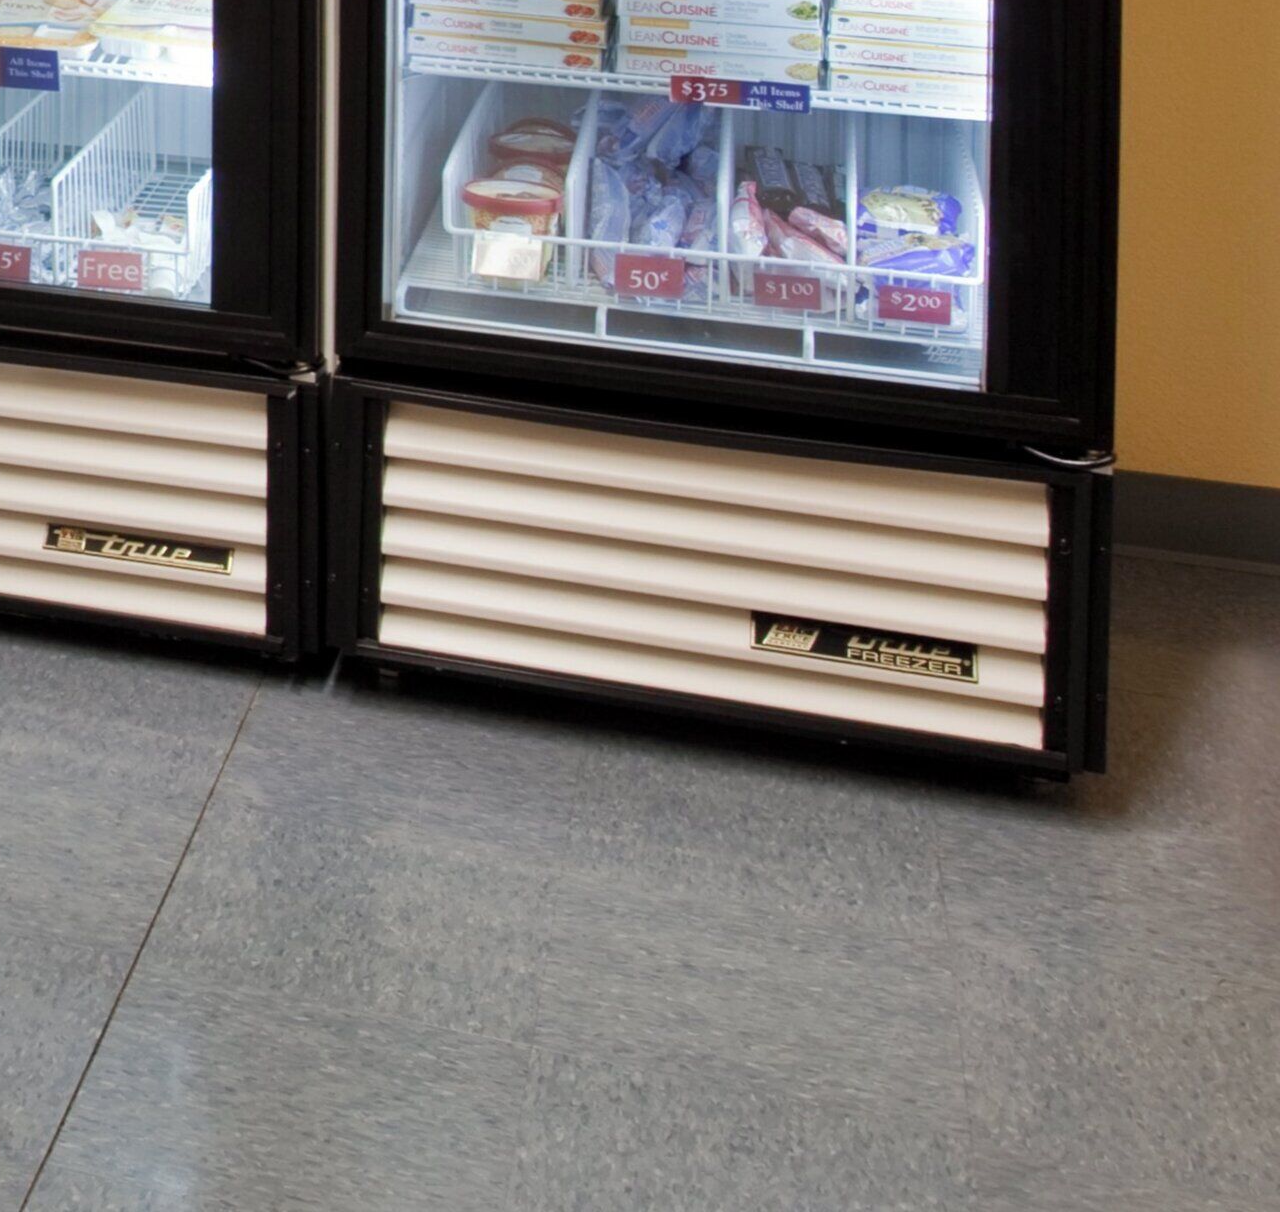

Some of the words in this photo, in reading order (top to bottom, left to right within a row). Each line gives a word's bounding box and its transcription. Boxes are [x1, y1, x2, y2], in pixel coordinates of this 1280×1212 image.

[9, 57, 23, 66] All
[26, 58, 51, 68] Items
[8, 68, 29, 77] This
[31, 69, 54, 79] Shelf
[751, 86, 767, 95] All
[771, 86, 801, 98] Items
[747, 98, 772, 108] This
[776, 99, 805, 111] Shelf
[82, 257, 141, 282] Free
[630, 270, 669, 290] 50¢
[101, 535, 192, 562] true
[847, 648, 962, 675] FREEZER
